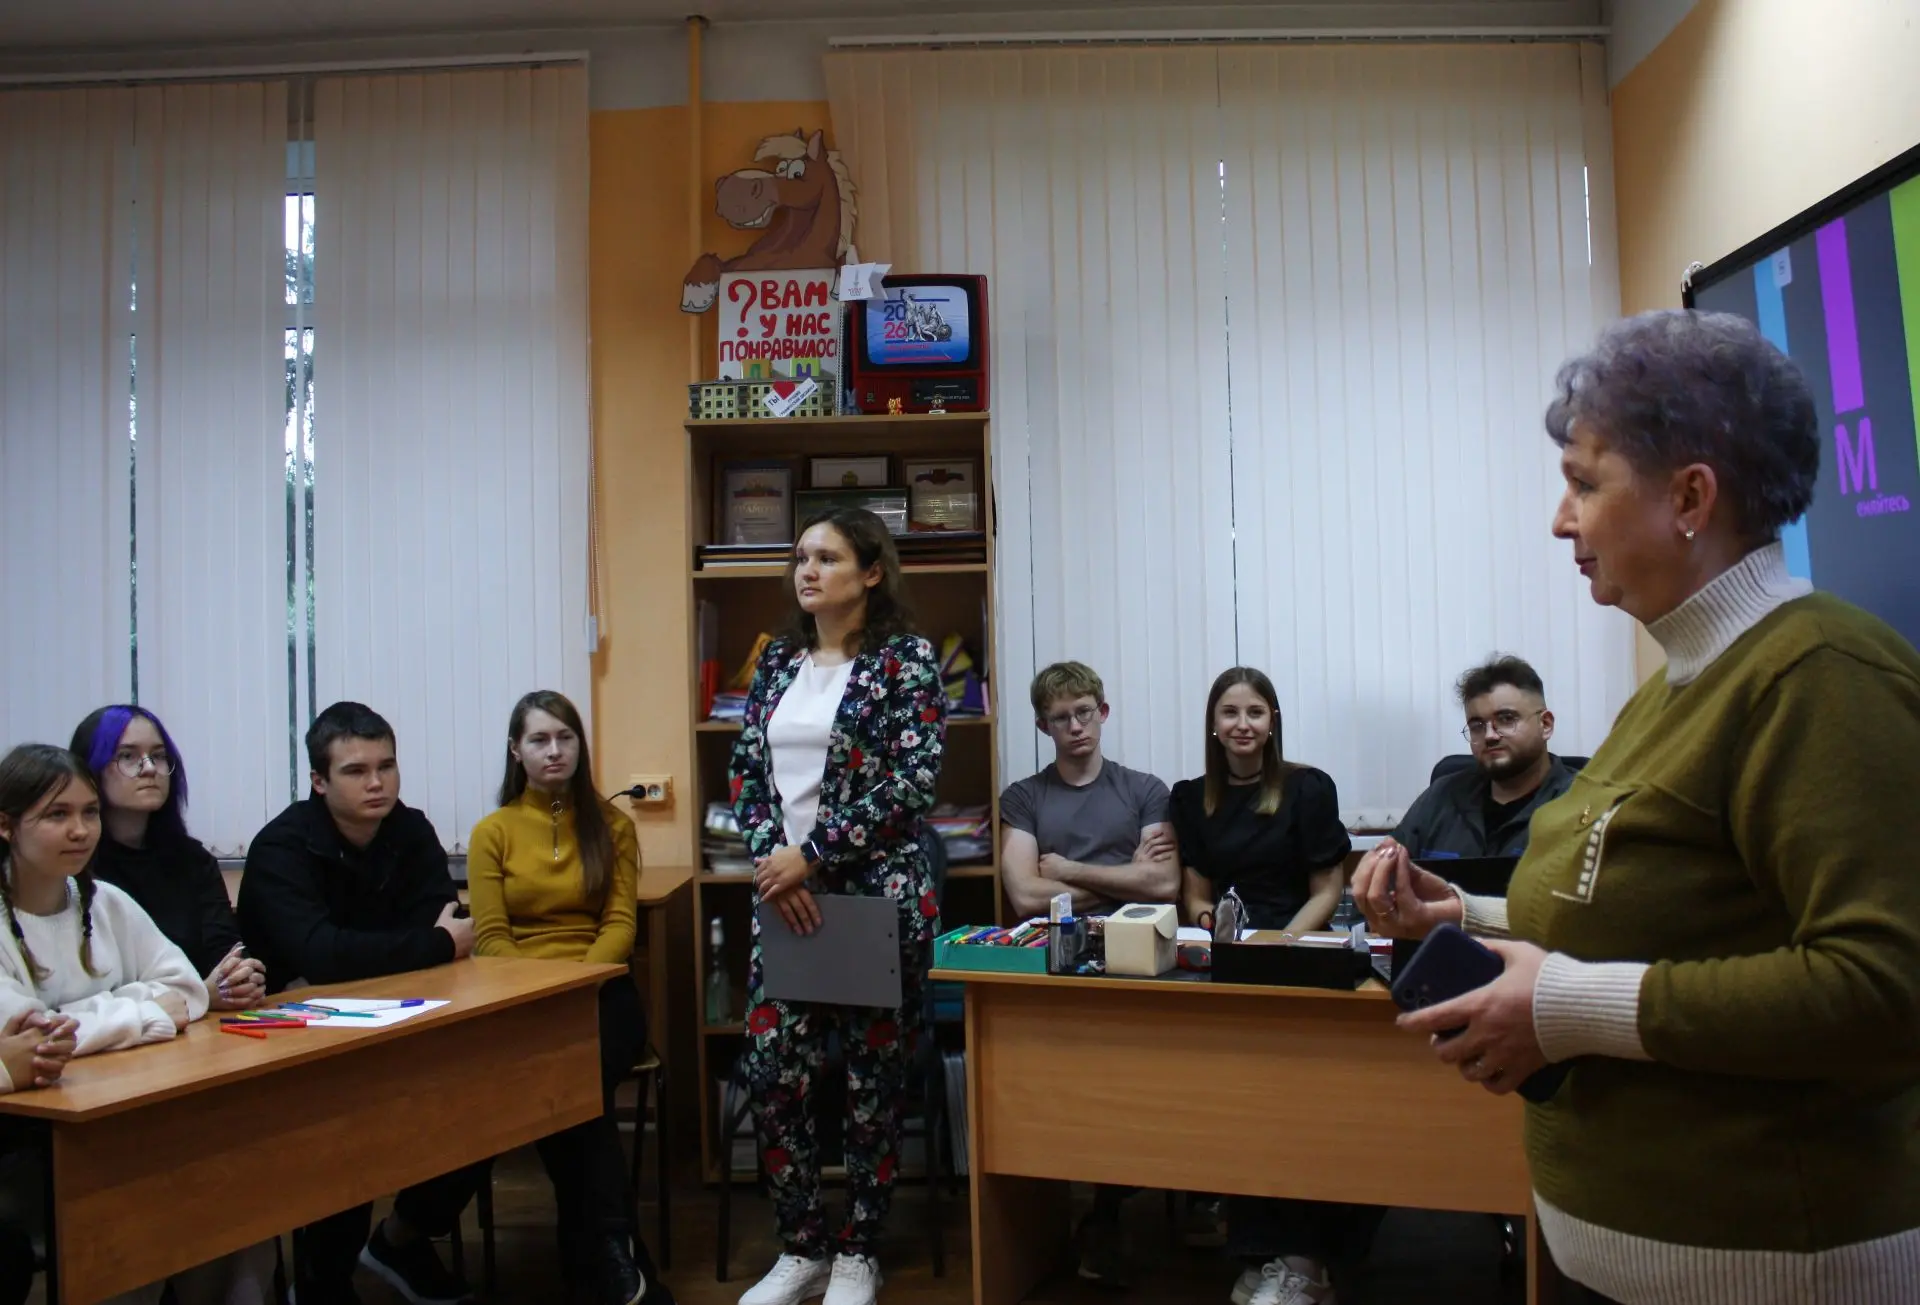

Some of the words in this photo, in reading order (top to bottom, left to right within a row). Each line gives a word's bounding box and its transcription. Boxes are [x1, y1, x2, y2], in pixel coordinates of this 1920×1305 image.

[760, 279, 828, 310] ВАМ
[759, 312, 777, 338] У
[785, 312, 831, 337] НАС
[883, 304, 906, 322] 20
[883, 321, 908, 339] 26
[719, 337, 838, 363] ПОНРАВИЛОС
[1833, 416, 1878, 496] М
